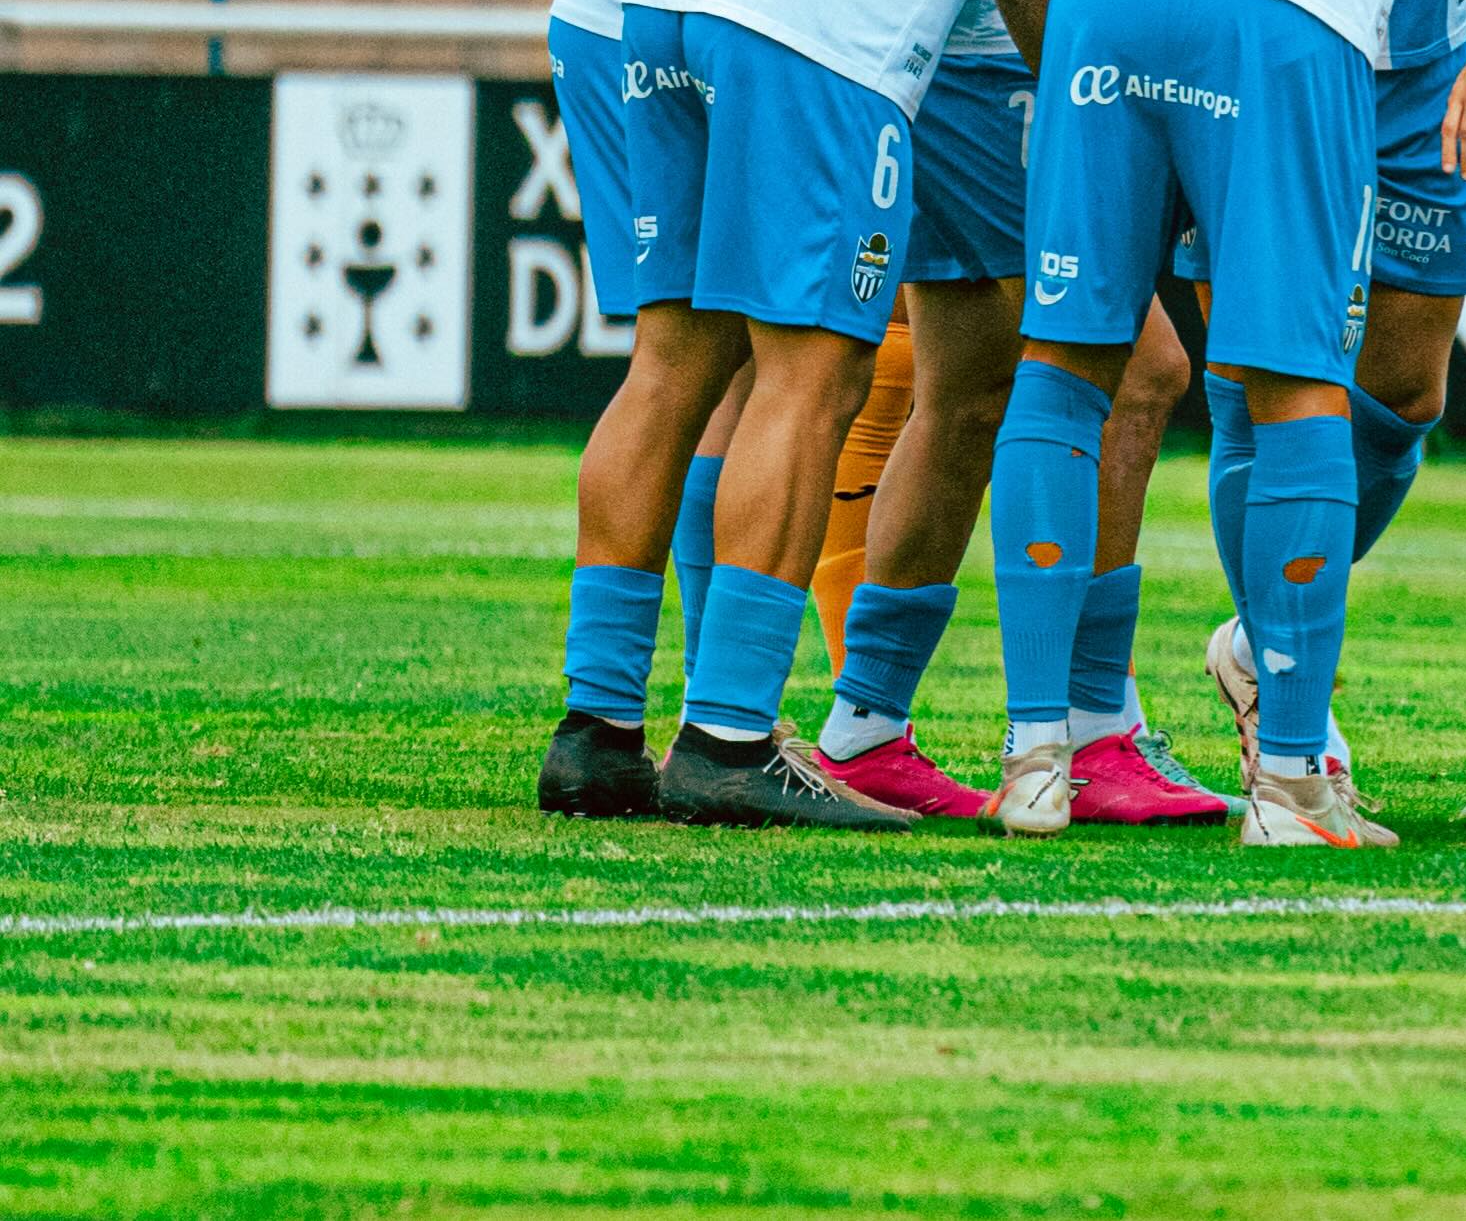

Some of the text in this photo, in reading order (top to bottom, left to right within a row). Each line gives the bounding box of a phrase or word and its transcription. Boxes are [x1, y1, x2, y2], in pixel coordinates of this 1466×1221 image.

[871, 123, 901, 210] 6
[1375, 196, 1452, 228] FONT
[1375, 221, 1452, 254] ORDA
